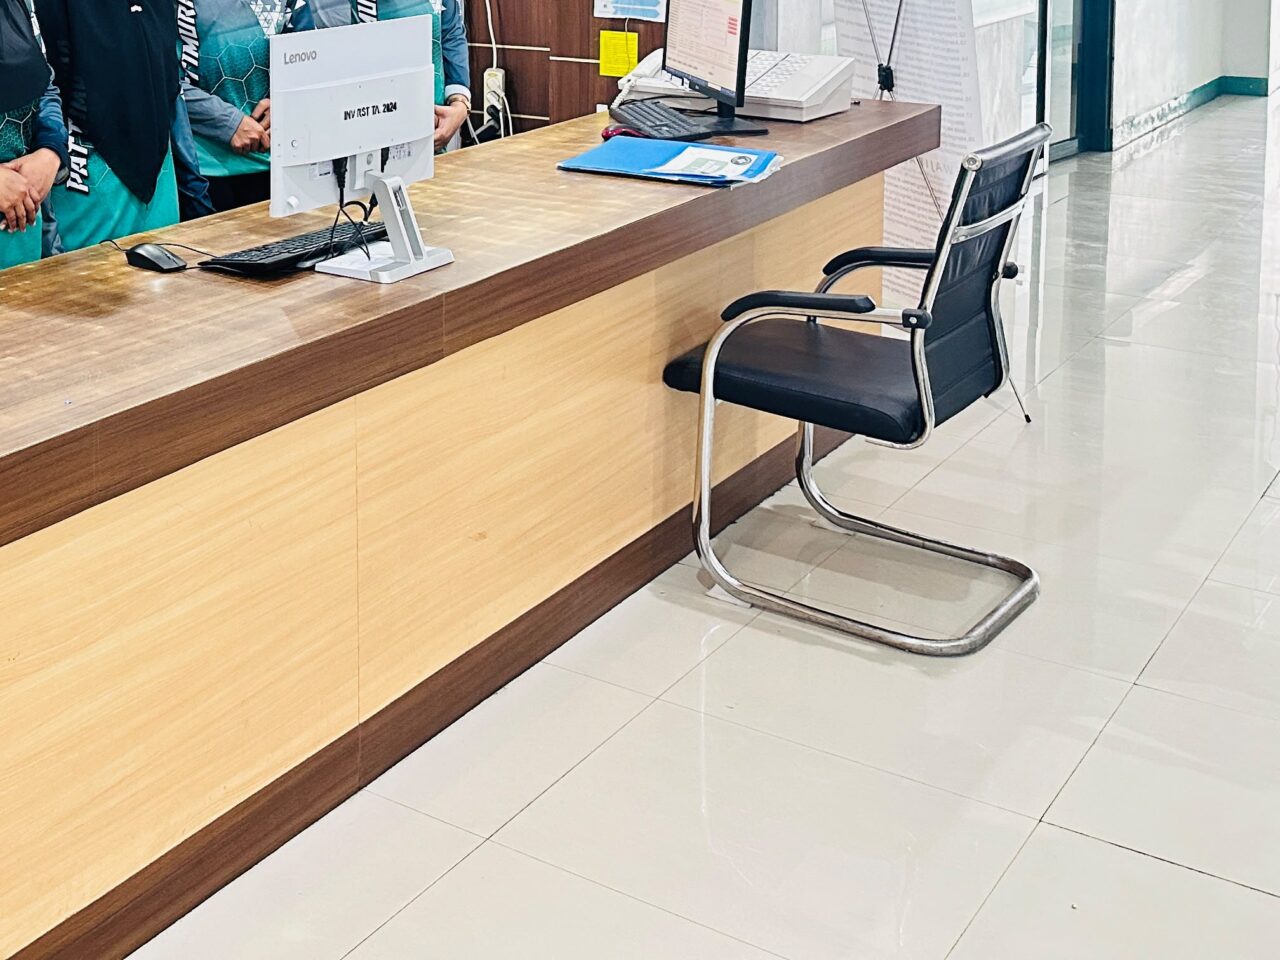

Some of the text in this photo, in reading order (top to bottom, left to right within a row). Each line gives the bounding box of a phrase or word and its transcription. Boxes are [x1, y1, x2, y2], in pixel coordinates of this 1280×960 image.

[283, 50, 317, 65] Lenovo
[344, 109, 356, 121] INV
[357, 106, 370, 118] RST
